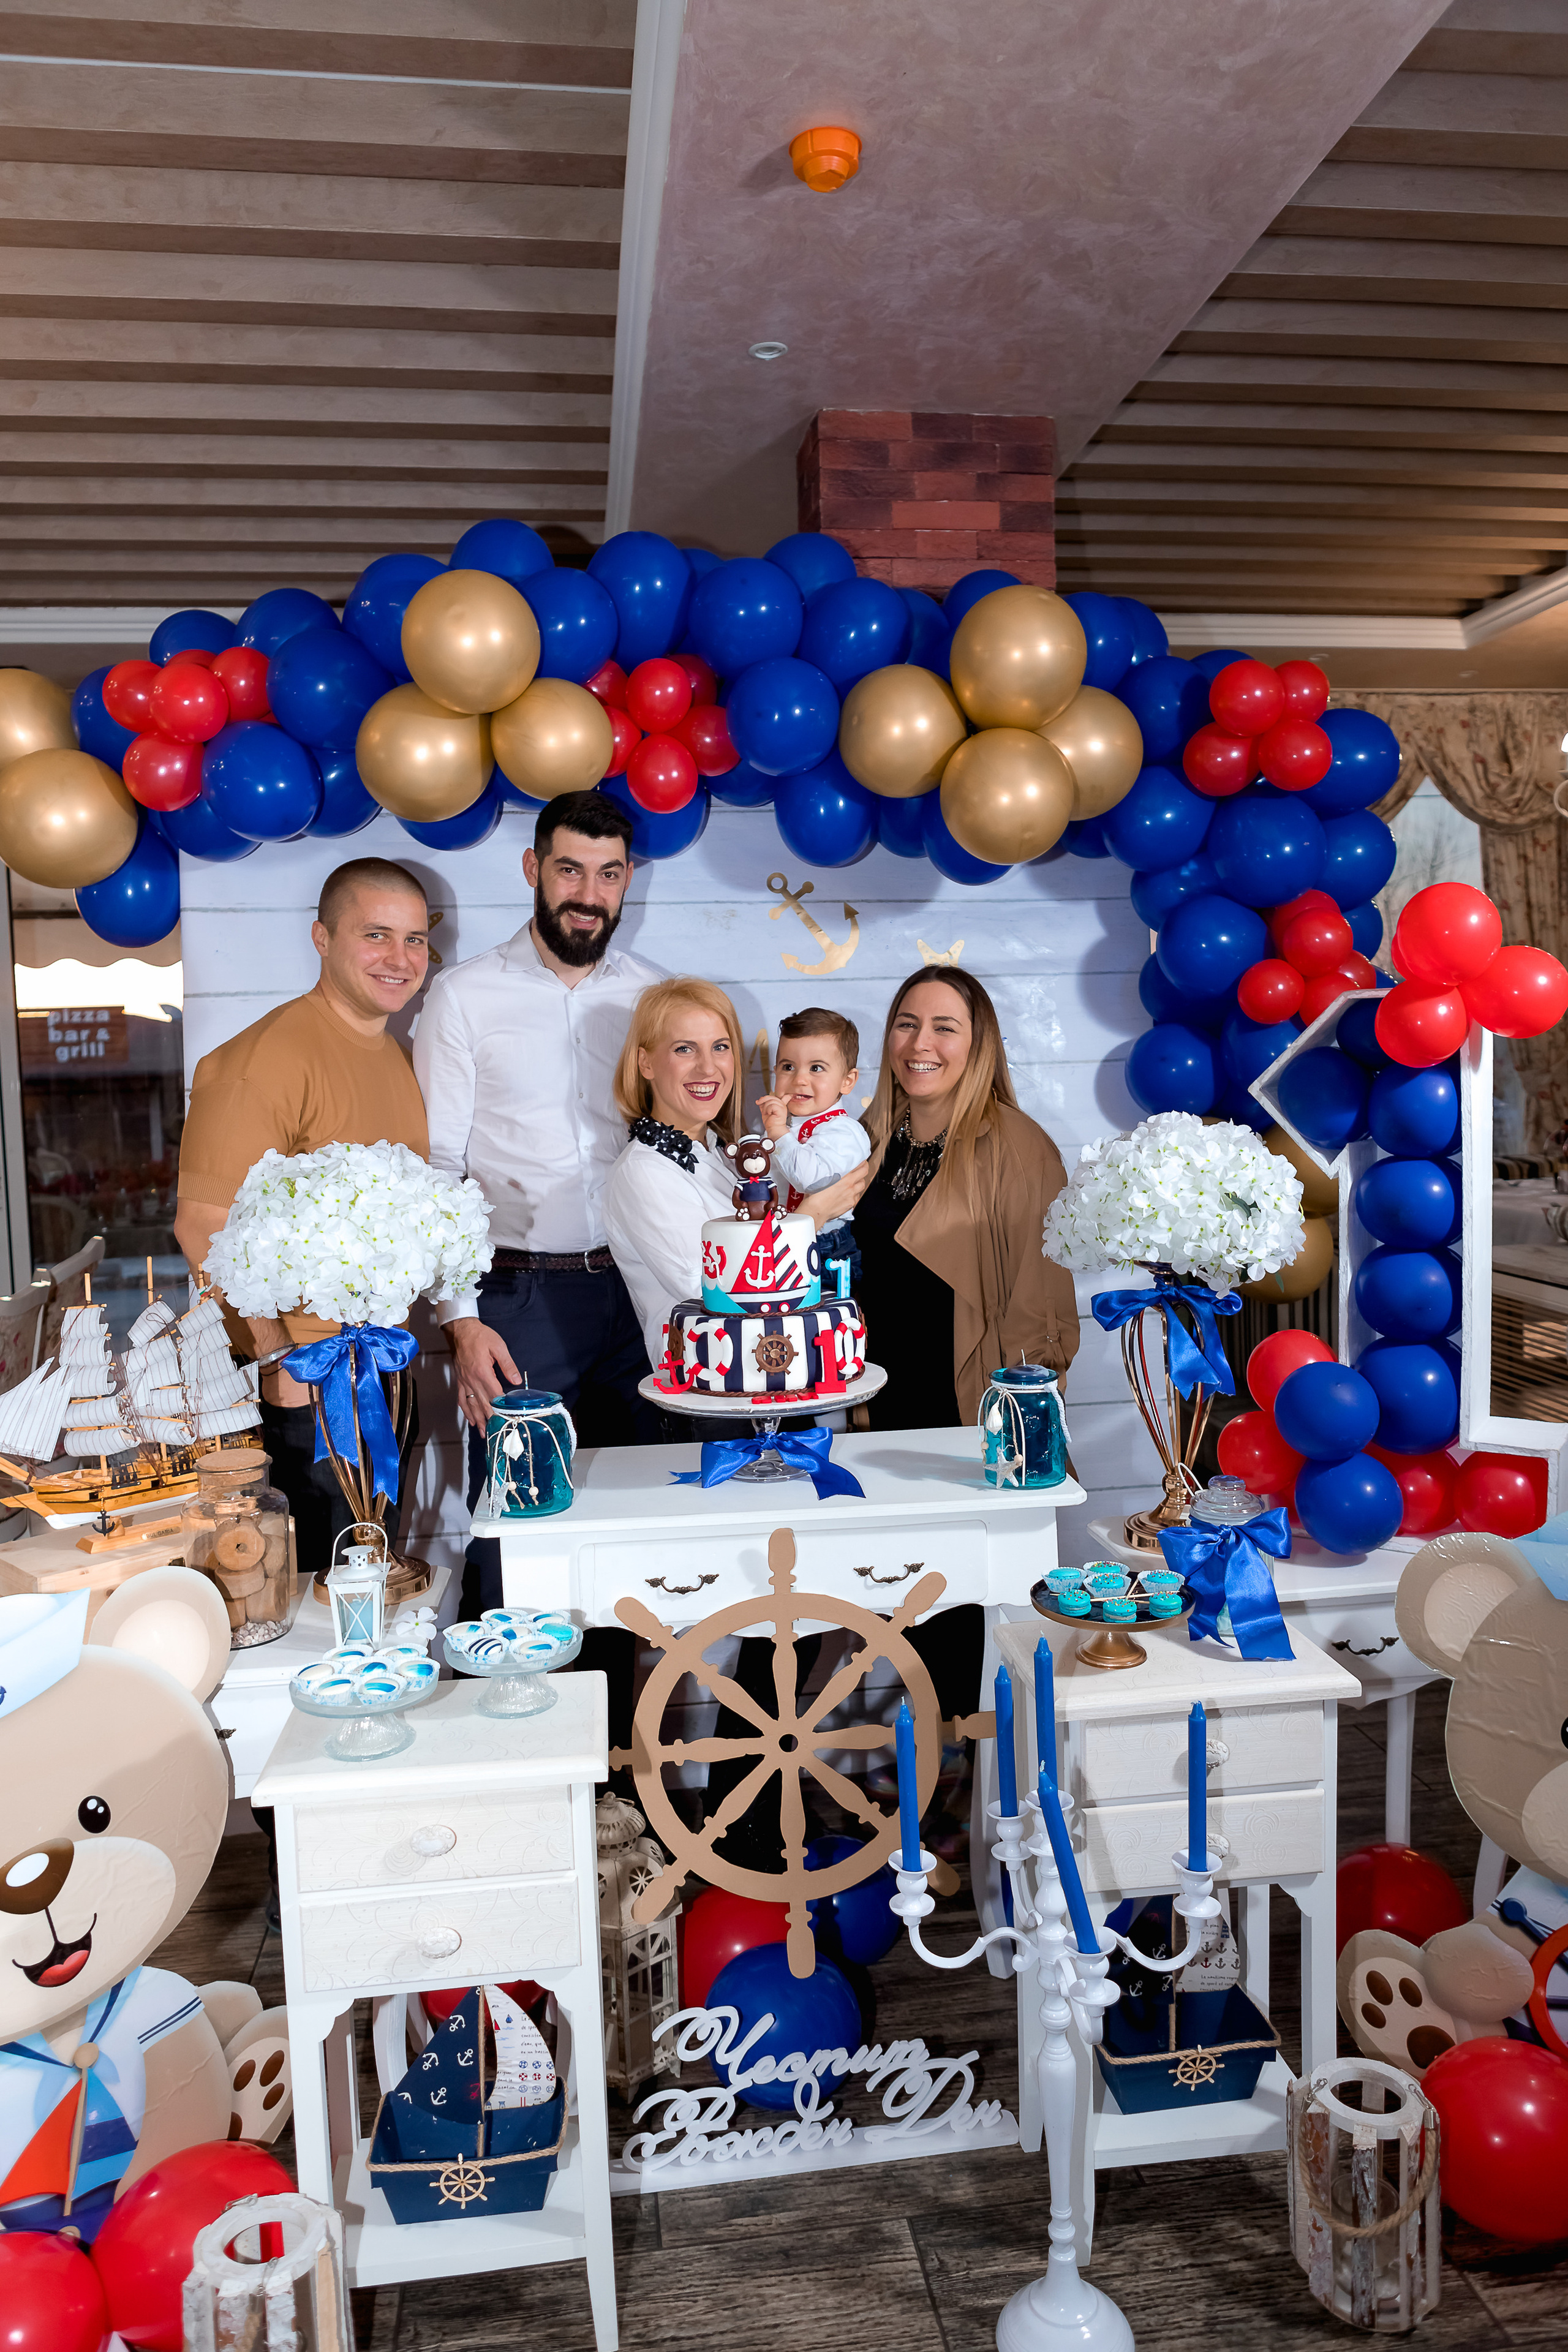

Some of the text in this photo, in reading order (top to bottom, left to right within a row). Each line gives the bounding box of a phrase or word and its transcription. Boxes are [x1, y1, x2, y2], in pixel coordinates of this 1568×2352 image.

[47, 1009, 110, 1027] pizza
[48, 1026, 110, 1043] bar &
[55, 1041, 105, 1063] grill
[651, 2005, 930, 2087] Честит
[863, 2050, 1003, 2144] Ден
